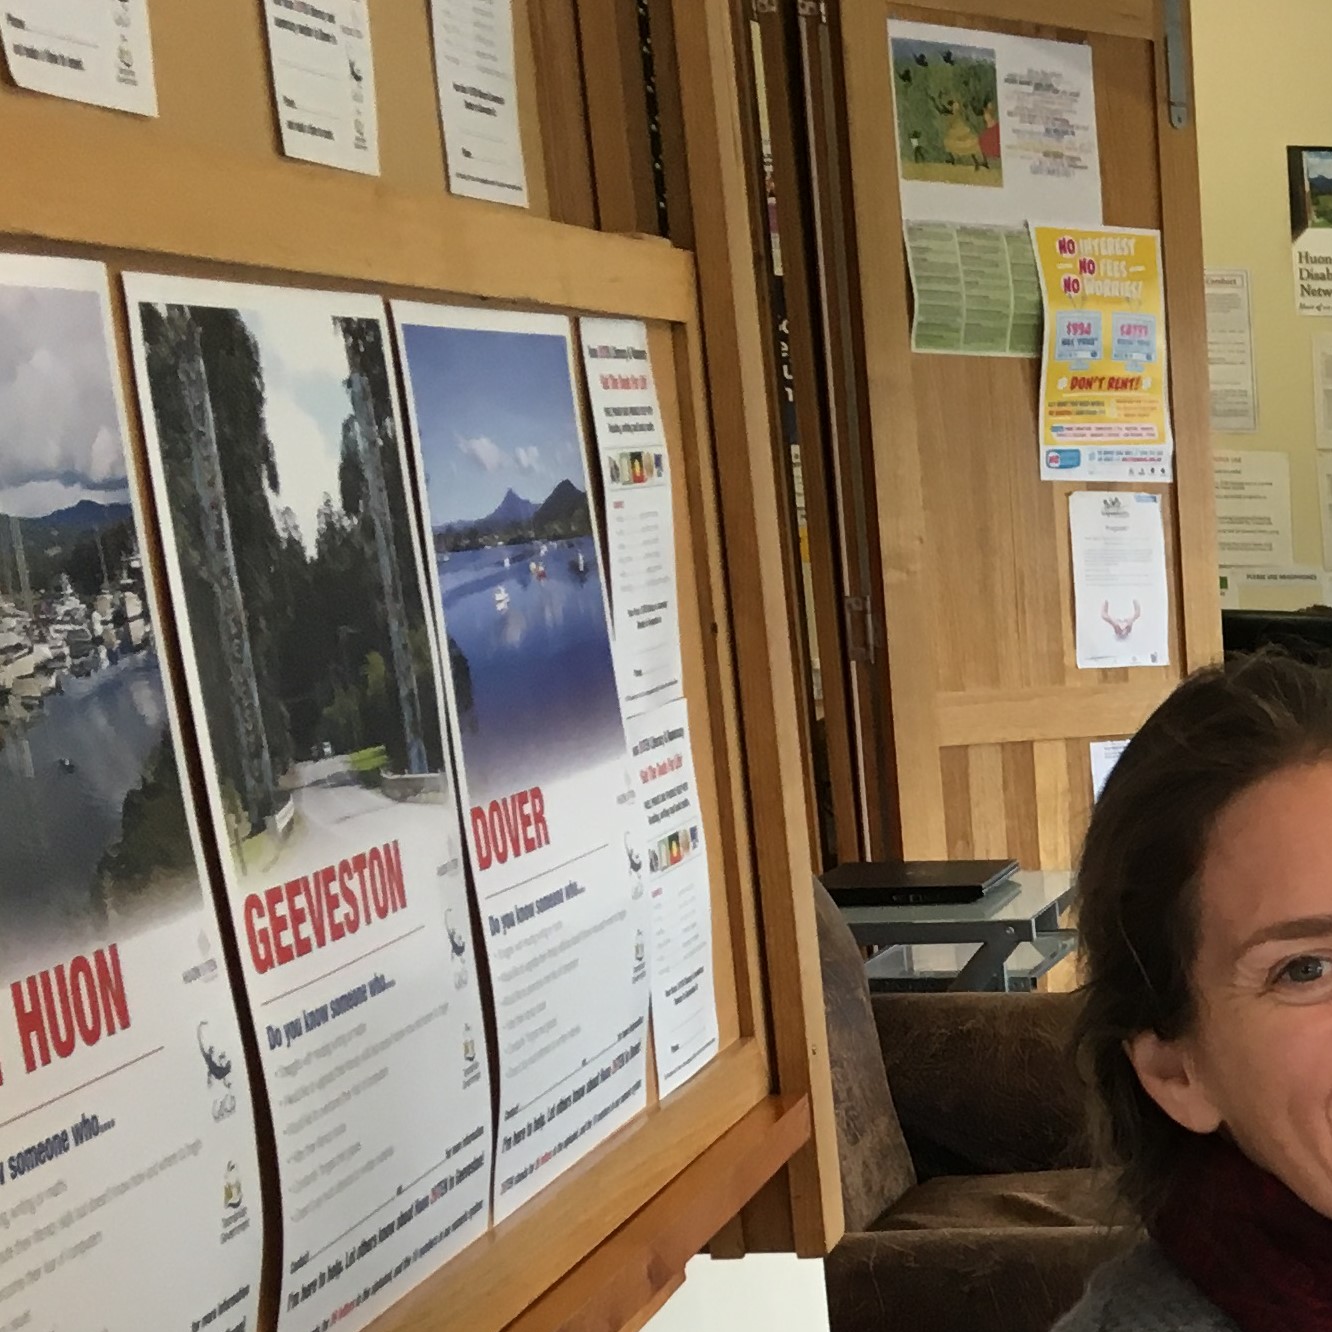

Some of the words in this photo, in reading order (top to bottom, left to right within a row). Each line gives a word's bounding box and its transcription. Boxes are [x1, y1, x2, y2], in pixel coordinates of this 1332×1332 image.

[1058, 238, 1076, 255] NO
[1080, 237, 1135, 256] INTEREST
[1298, 251, 1332, 265] Huon
[1079, 258, 1096, 275] NO
[1100, 259, 1128, 277] FEES
[1063, 276, 1080, 294] NO
[1070, 376, 1105, 390] DON'T
[1107, 376, 1141, 391] RENT!
[470, 786, 550, 872] DOVER
[244, 839, 407, 975] GEEVESTON
[10, 943, 131, 1073] HUON
[265, 1025, 283, 1051] Do
[283, 1017, 303, 1049] you
[303, 1003, 329, 1032] know
[330, 983, 369, 1019] someone
[8, 1129, 69, 1179] someone
